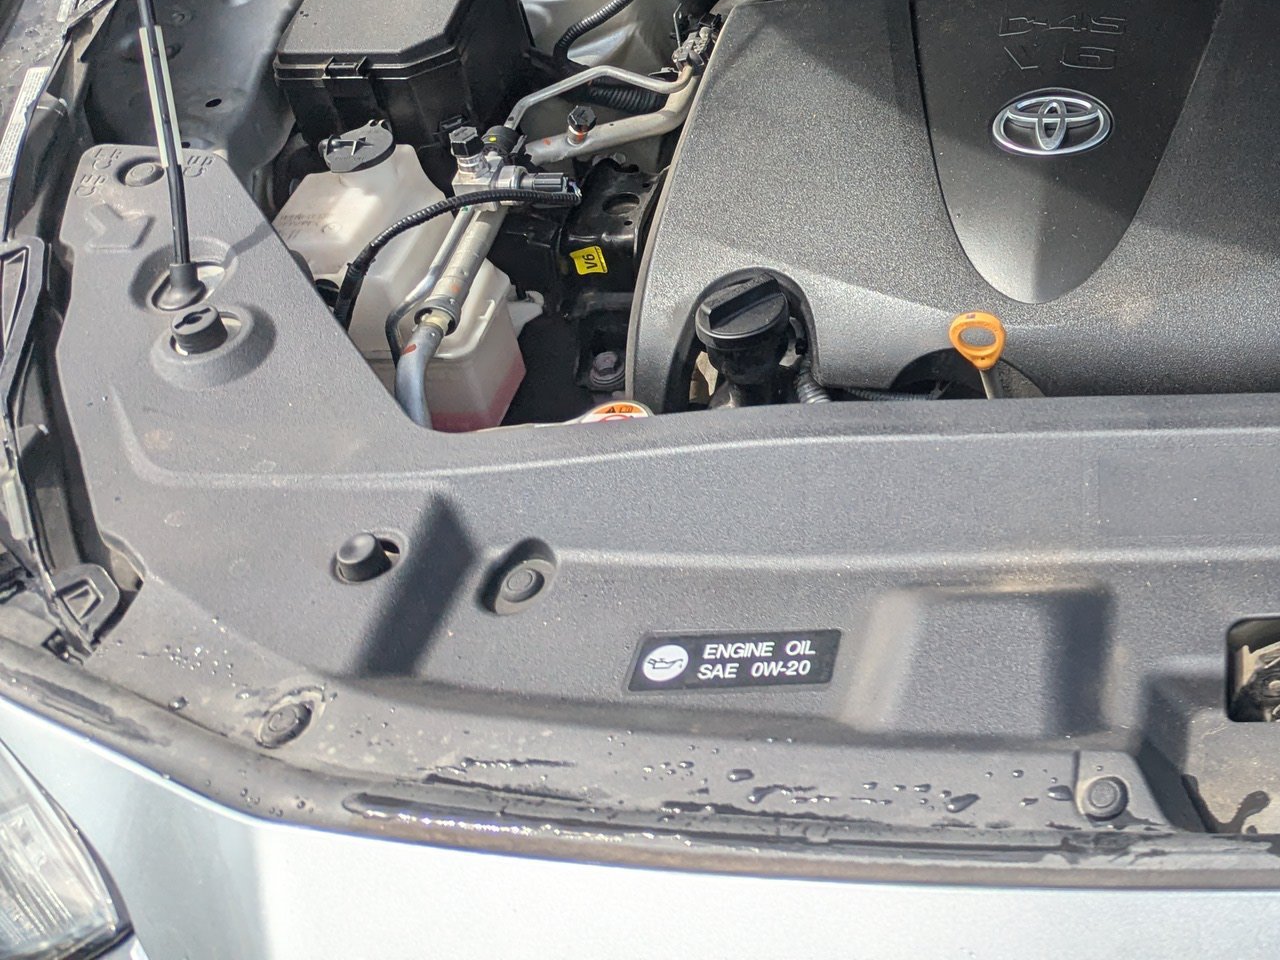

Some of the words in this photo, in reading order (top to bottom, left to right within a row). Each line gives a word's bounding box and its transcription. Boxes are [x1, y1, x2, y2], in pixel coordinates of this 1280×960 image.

[582, 253, 598, 270] V6
[703, 642, 775, 659] ENGINE
[785, 640, 816, 656] OIL
[697, 663, 739, 679] SAE
[751, 660, 811, 677] 0W-20
